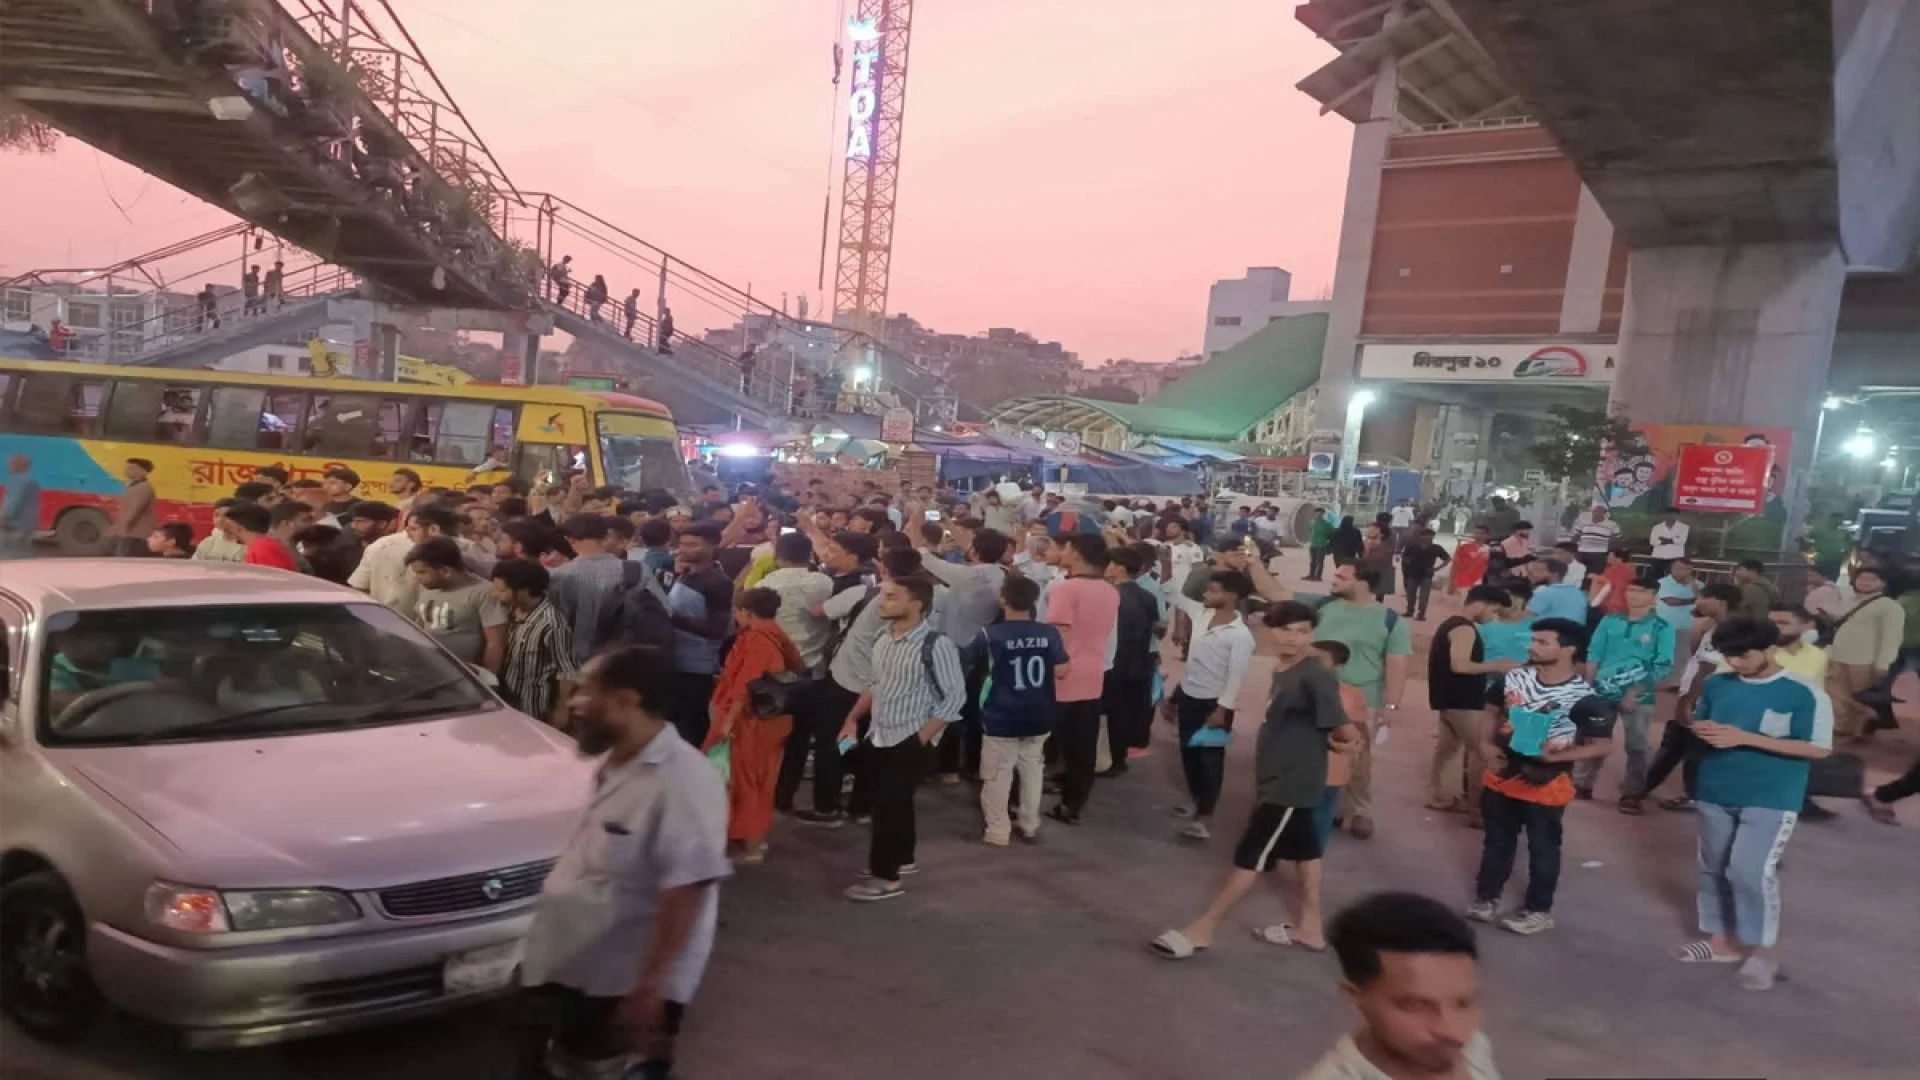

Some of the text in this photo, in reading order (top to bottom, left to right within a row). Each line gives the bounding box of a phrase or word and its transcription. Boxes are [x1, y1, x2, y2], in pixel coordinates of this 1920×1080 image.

[1475, 356, 1502, 368] ১০
[1007, 638, 1048, 649] RAZIB
[1009, 656, 1046, 690] 10
